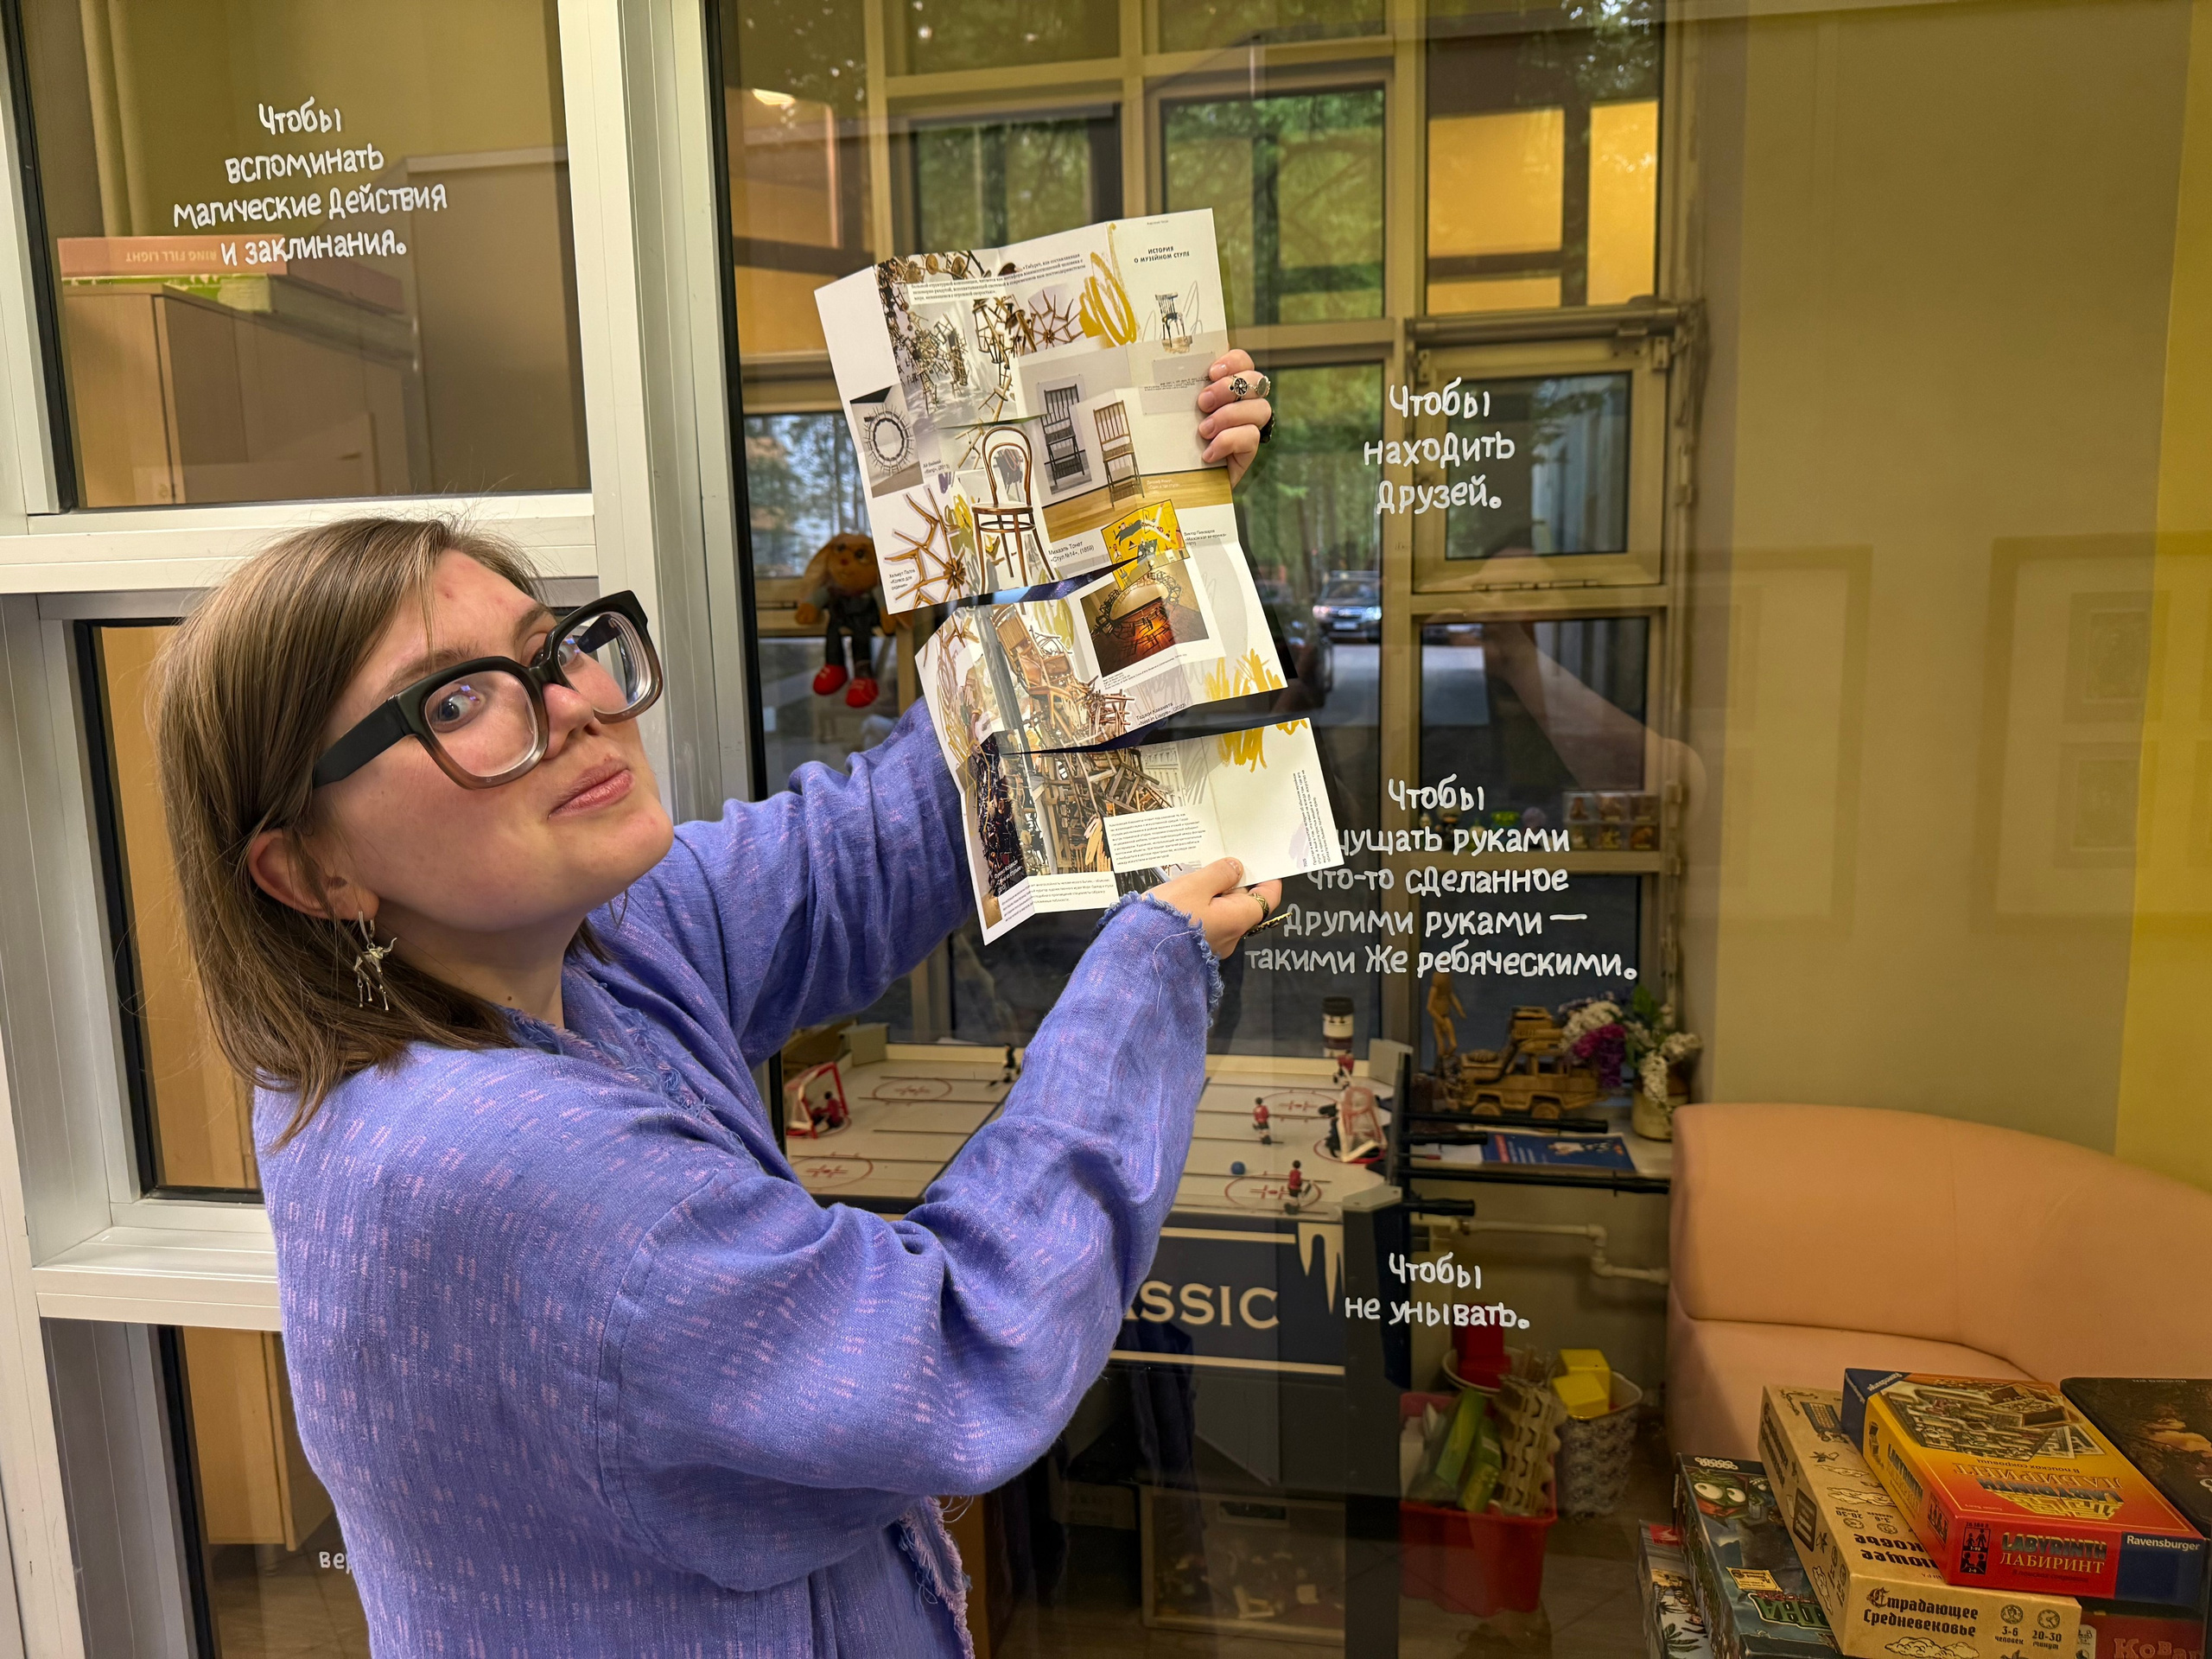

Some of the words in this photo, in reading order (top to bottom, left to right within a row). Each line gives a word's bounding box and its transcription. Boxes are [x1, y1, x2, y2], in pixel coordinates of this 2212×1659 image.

[258, 96, 341, 136] Чтобы
[226, 143, 385, 184] вспоминать
[174, 193, 322, 229] магические
[125, 251, 159, 263] LIGHT
[162, 250, 185, 262] FILL
[220, 243, 238, 266] и
[245, 230, 407, 266] заклинания.
[1141, 254, 1172, 263] МУЗЕЙНОМ
[1389, 377, 1491, 419] Чтобы
[1363, 430, 1516, 469] находить
[1388, 774, 1484, 811] Чтобы
[1452, 827, 1570, 856] руками
[1405, 866, 1569, 898] сделанное
[1425, 911, 1542, 939] руками
[1244, 948, 1356, 975] такими
[1417, 939, 1637, 981] ребяческими.
[1389, 1252, 1482, 1290] Чтобы
[1344, 1297, 1381, 1319] не
[1389, 1301, 1530, 1330] унывать.
[1952, 1462, 2124, 1489] ЛАБИРИНТ
[1853, 1534, 1924, 1553] ковье
[2001, 1531, 2107, 1560] LABYRINTH
[2126, 1535, 2200, 1551] Ravensburger
[1860, 1549, 1939, 1569] ющее
[1999, 1553, 2105, 1574] ЛАБИРИНТ
[1866, 1586, 1979, 1620] Страдающее
[1863, 1608, 1977, 1637] Средневековье
[2000, 1625, 2018, 1637] 3-6
[2031, 1630, 2063, 1643] 20-30
